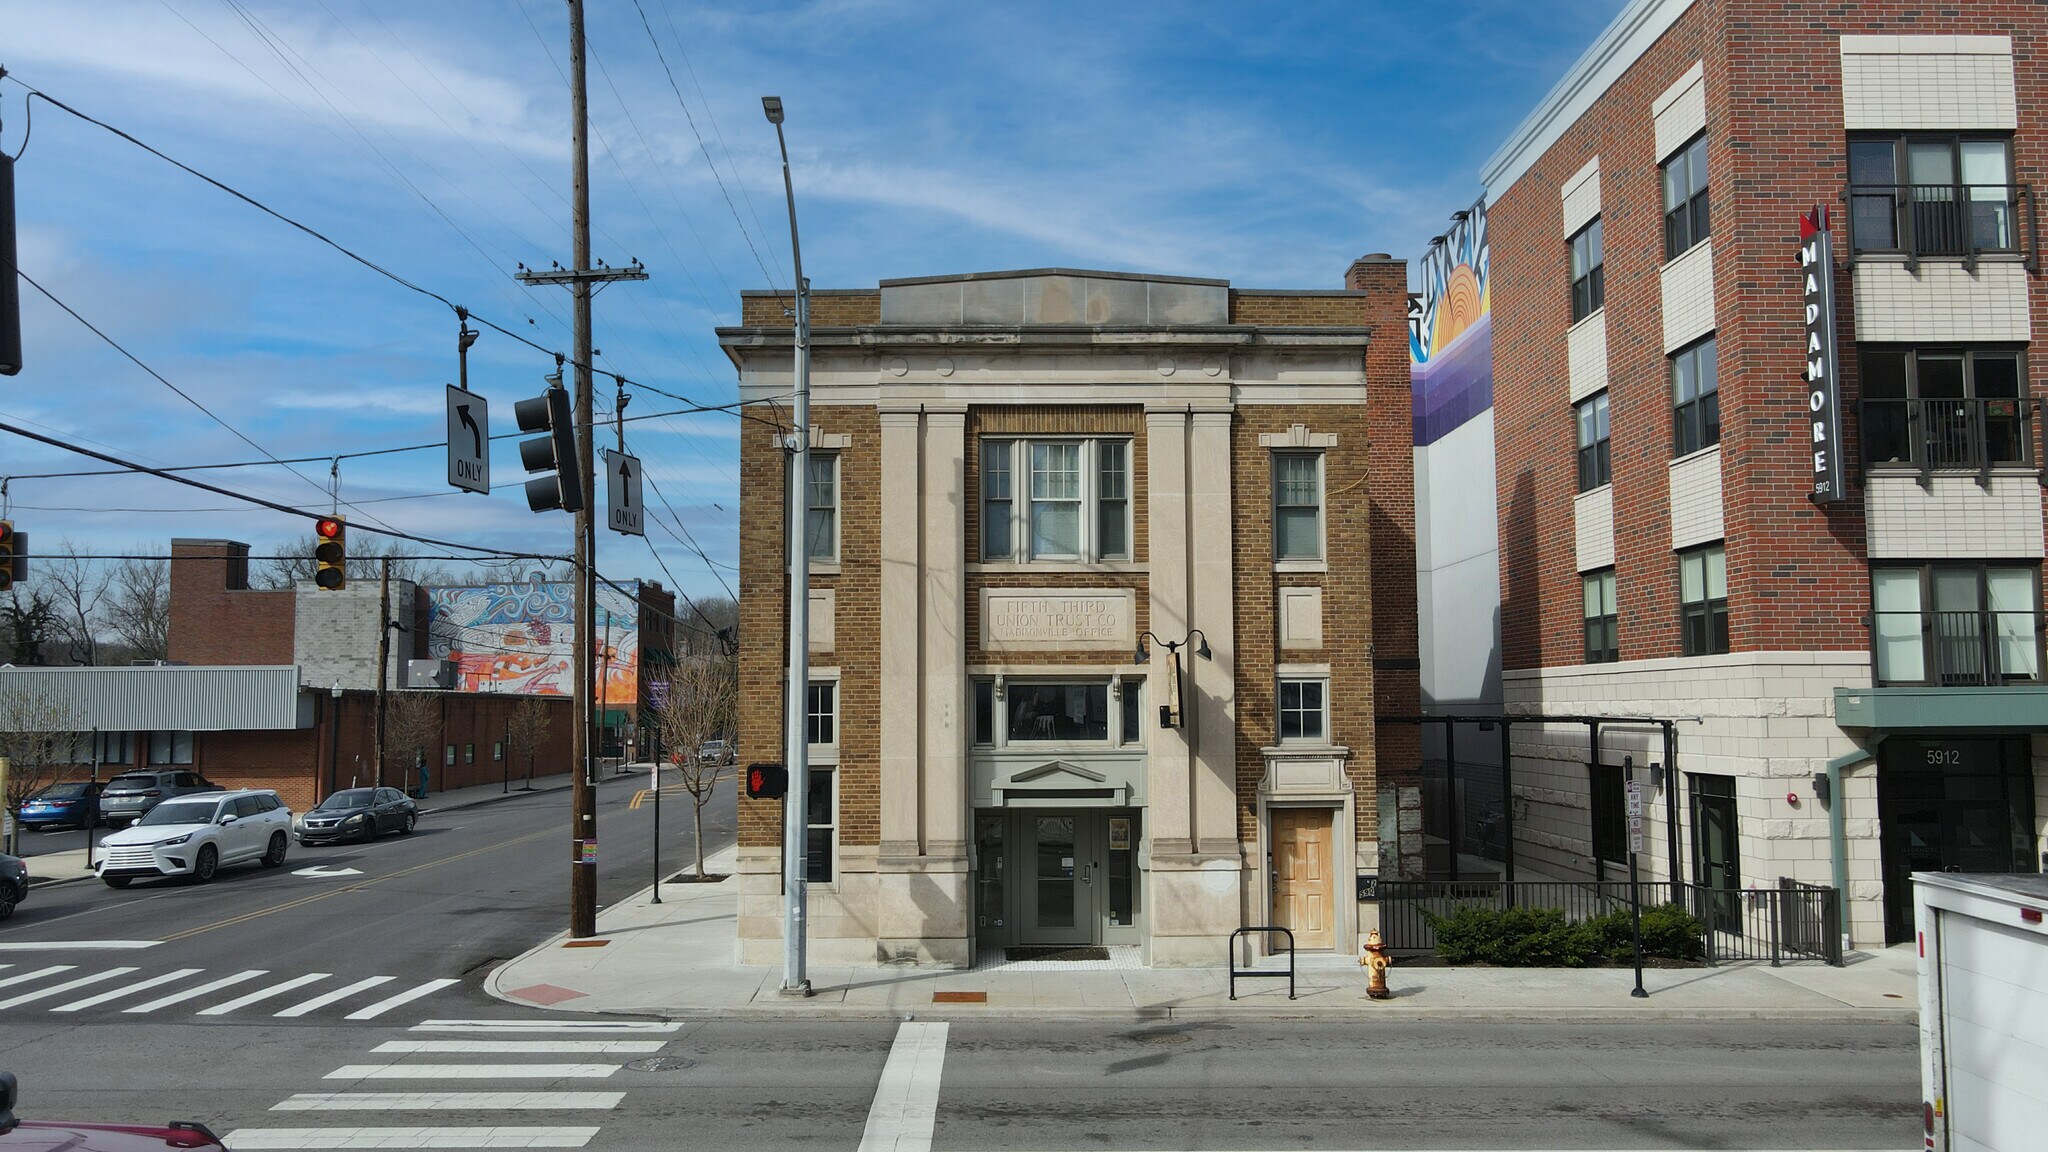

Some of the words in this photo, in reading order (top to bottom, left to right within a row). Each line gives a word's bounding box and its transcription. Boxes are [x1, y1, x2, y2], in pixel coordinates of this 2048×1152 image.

[1801, 242, 1827, 473] MADAMORE
[457, 459, 482, 482] ONLY
[1815, 481, 1830, 494] 5912
[615, 508, 637, 528] ONLY
[1007, 601, 1048, 613] FIFTH
[1061, 600, 1106, 613] THIRD
[997, 614, 1039, 626] UNION
[1047, 614, 1092, 626] TRUST
[1098, 614, 1116, 626] CO
[1000, 627, 1068, 637] MADISONVILLE
[1075, 627, 1113, 637] OFFICE
[1927, 749, 1960, 765] 5912
